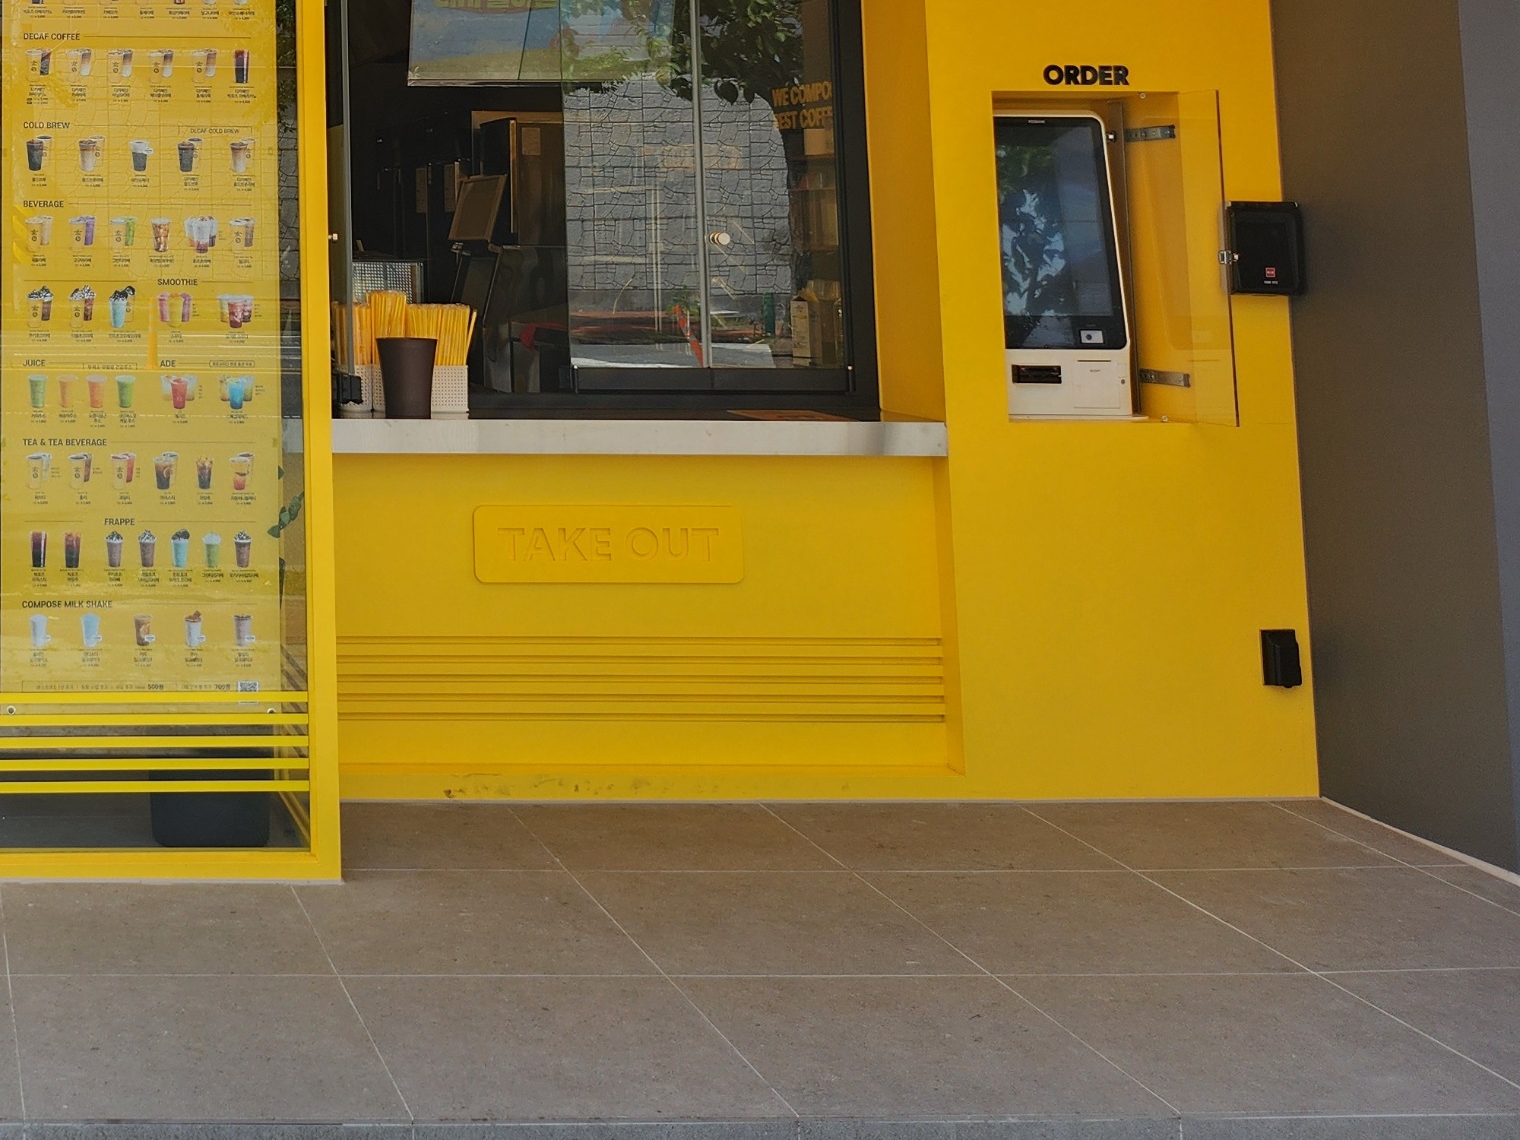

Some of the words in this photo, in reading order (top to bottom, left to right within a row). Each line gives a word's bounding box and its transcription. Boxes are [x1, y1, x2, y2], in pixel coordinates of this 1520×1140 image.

[23, 33, 49, 41] DECAF
[51, 33, 80, 41] COFFEE
[1043, 64, 1130, 86] ORDER
[771, 87, 790, 107] WE
[790, 81, 832, 105] COMPO
[23, 121, 44, 129] COLD
[46, 121, 70, 129] BREW
[23, 200, 64, 208] BEVERAGE
[157, 278, 198, 286] SMOOTHIE
[23, 359, 46, 367] JUICE
[23, 438, 38, 446] TEA
[40, 438, 46, 446] &
[48, 438, 63, 446] TEA
[65, 438, 107, 446] BEVERAGE
[104, 518, 135, 526] FRAPPE
[497, 527, 612, 562] TAKE
[625, 526, 720, 562] OUT
[22, 600, 62, 608] COMPOSE
[64, 600, 84, 608] MILK
[86, 600, 113, 608] SHAKE
